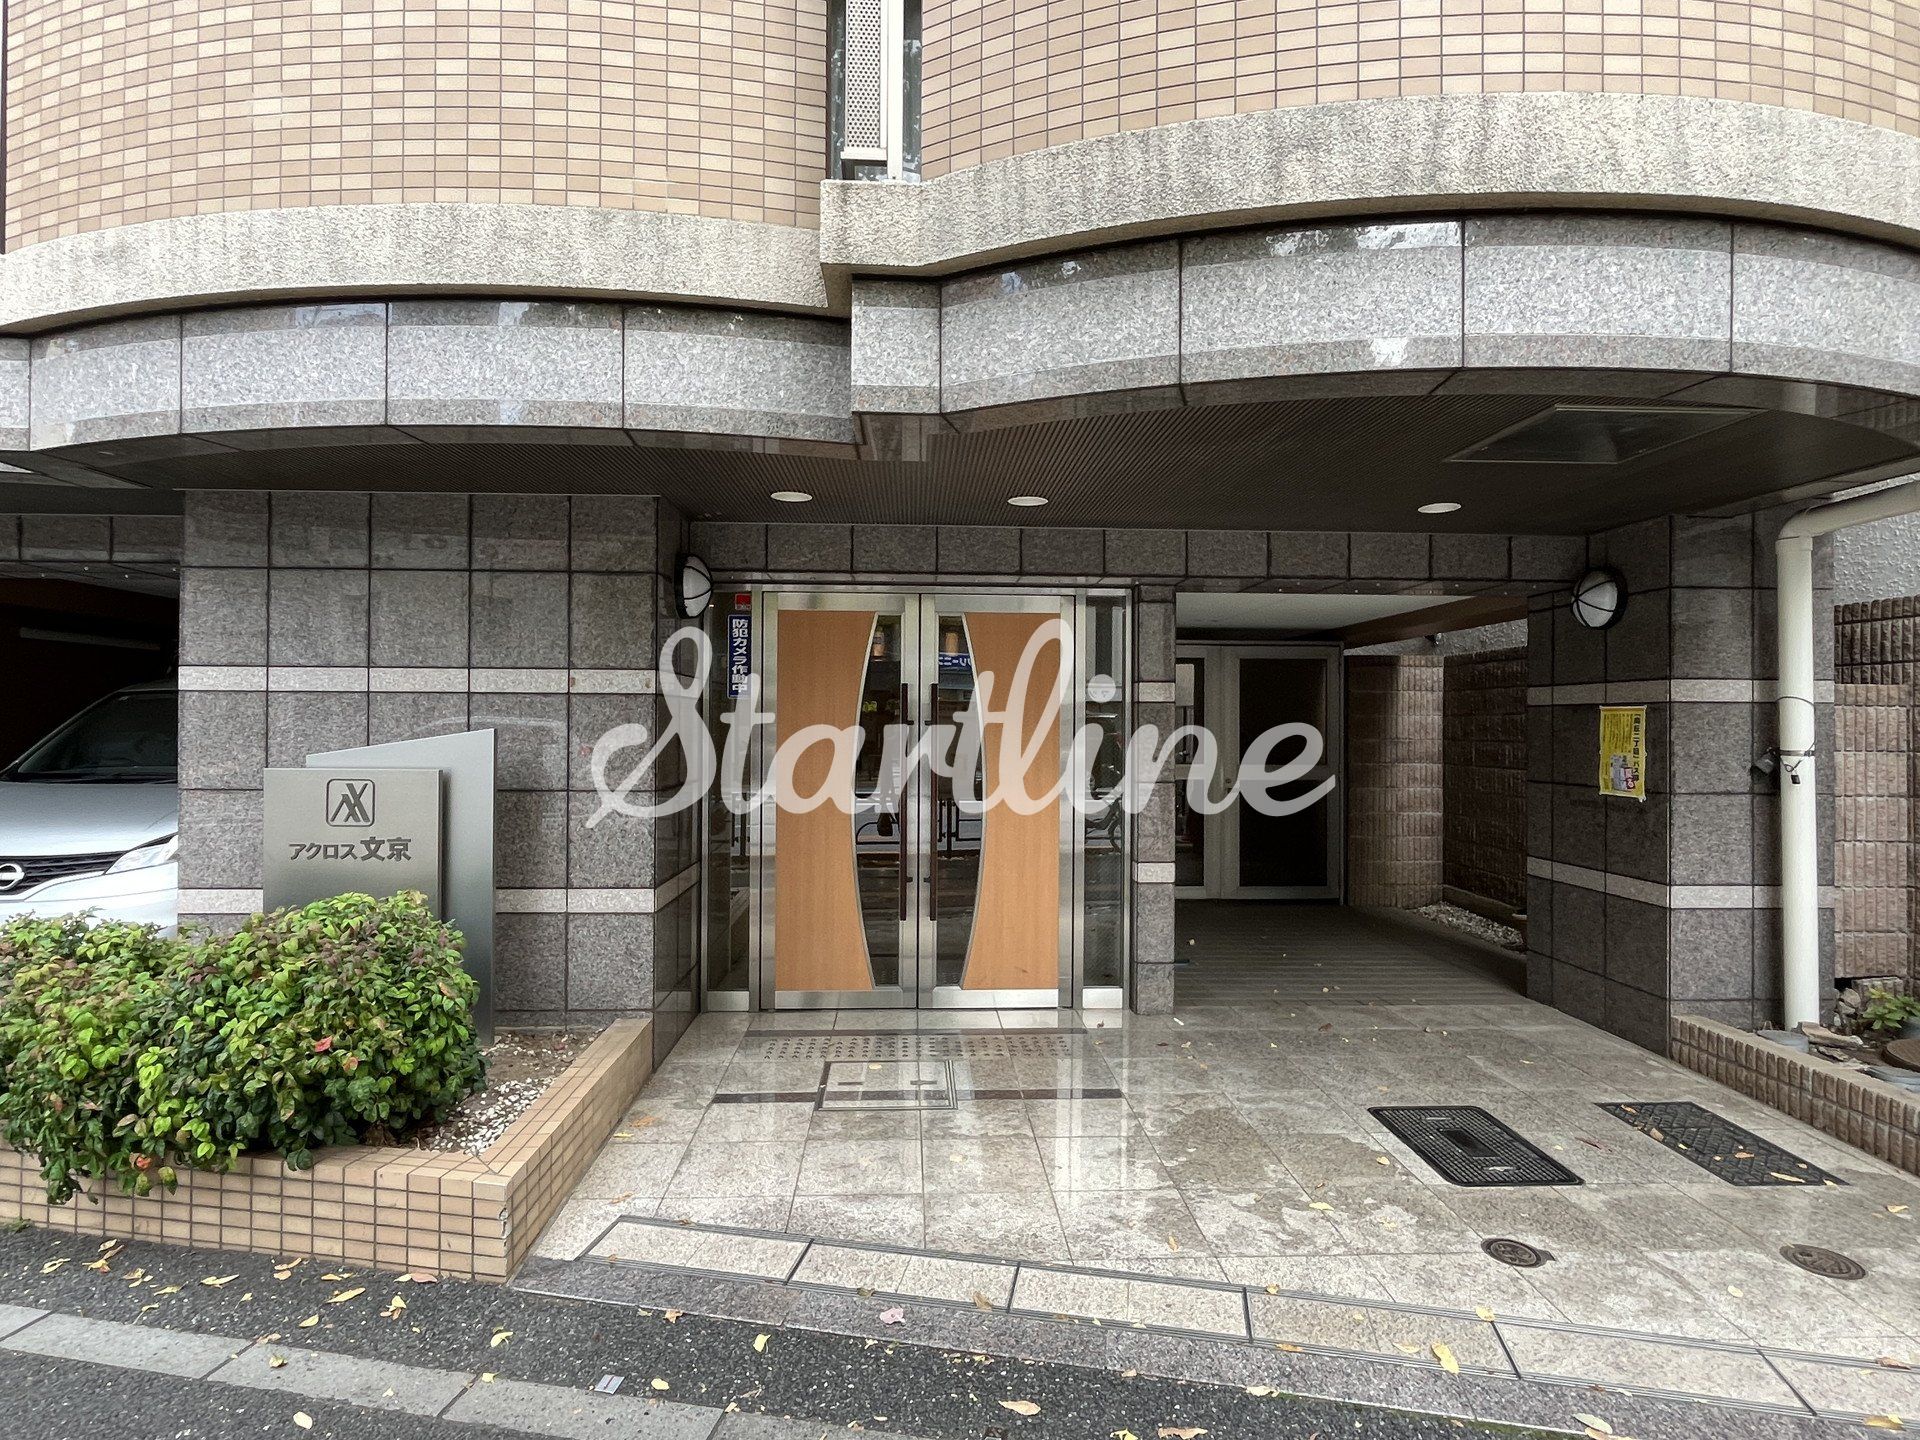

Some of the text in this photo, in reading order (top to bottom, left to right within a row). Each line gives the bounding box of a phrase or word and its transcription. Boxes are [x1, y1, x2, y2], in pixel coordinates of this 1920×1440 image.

[731, 618, 749, 693] 防犯カメラ作動中
[289, 836, 412, 862] アクロス文京
